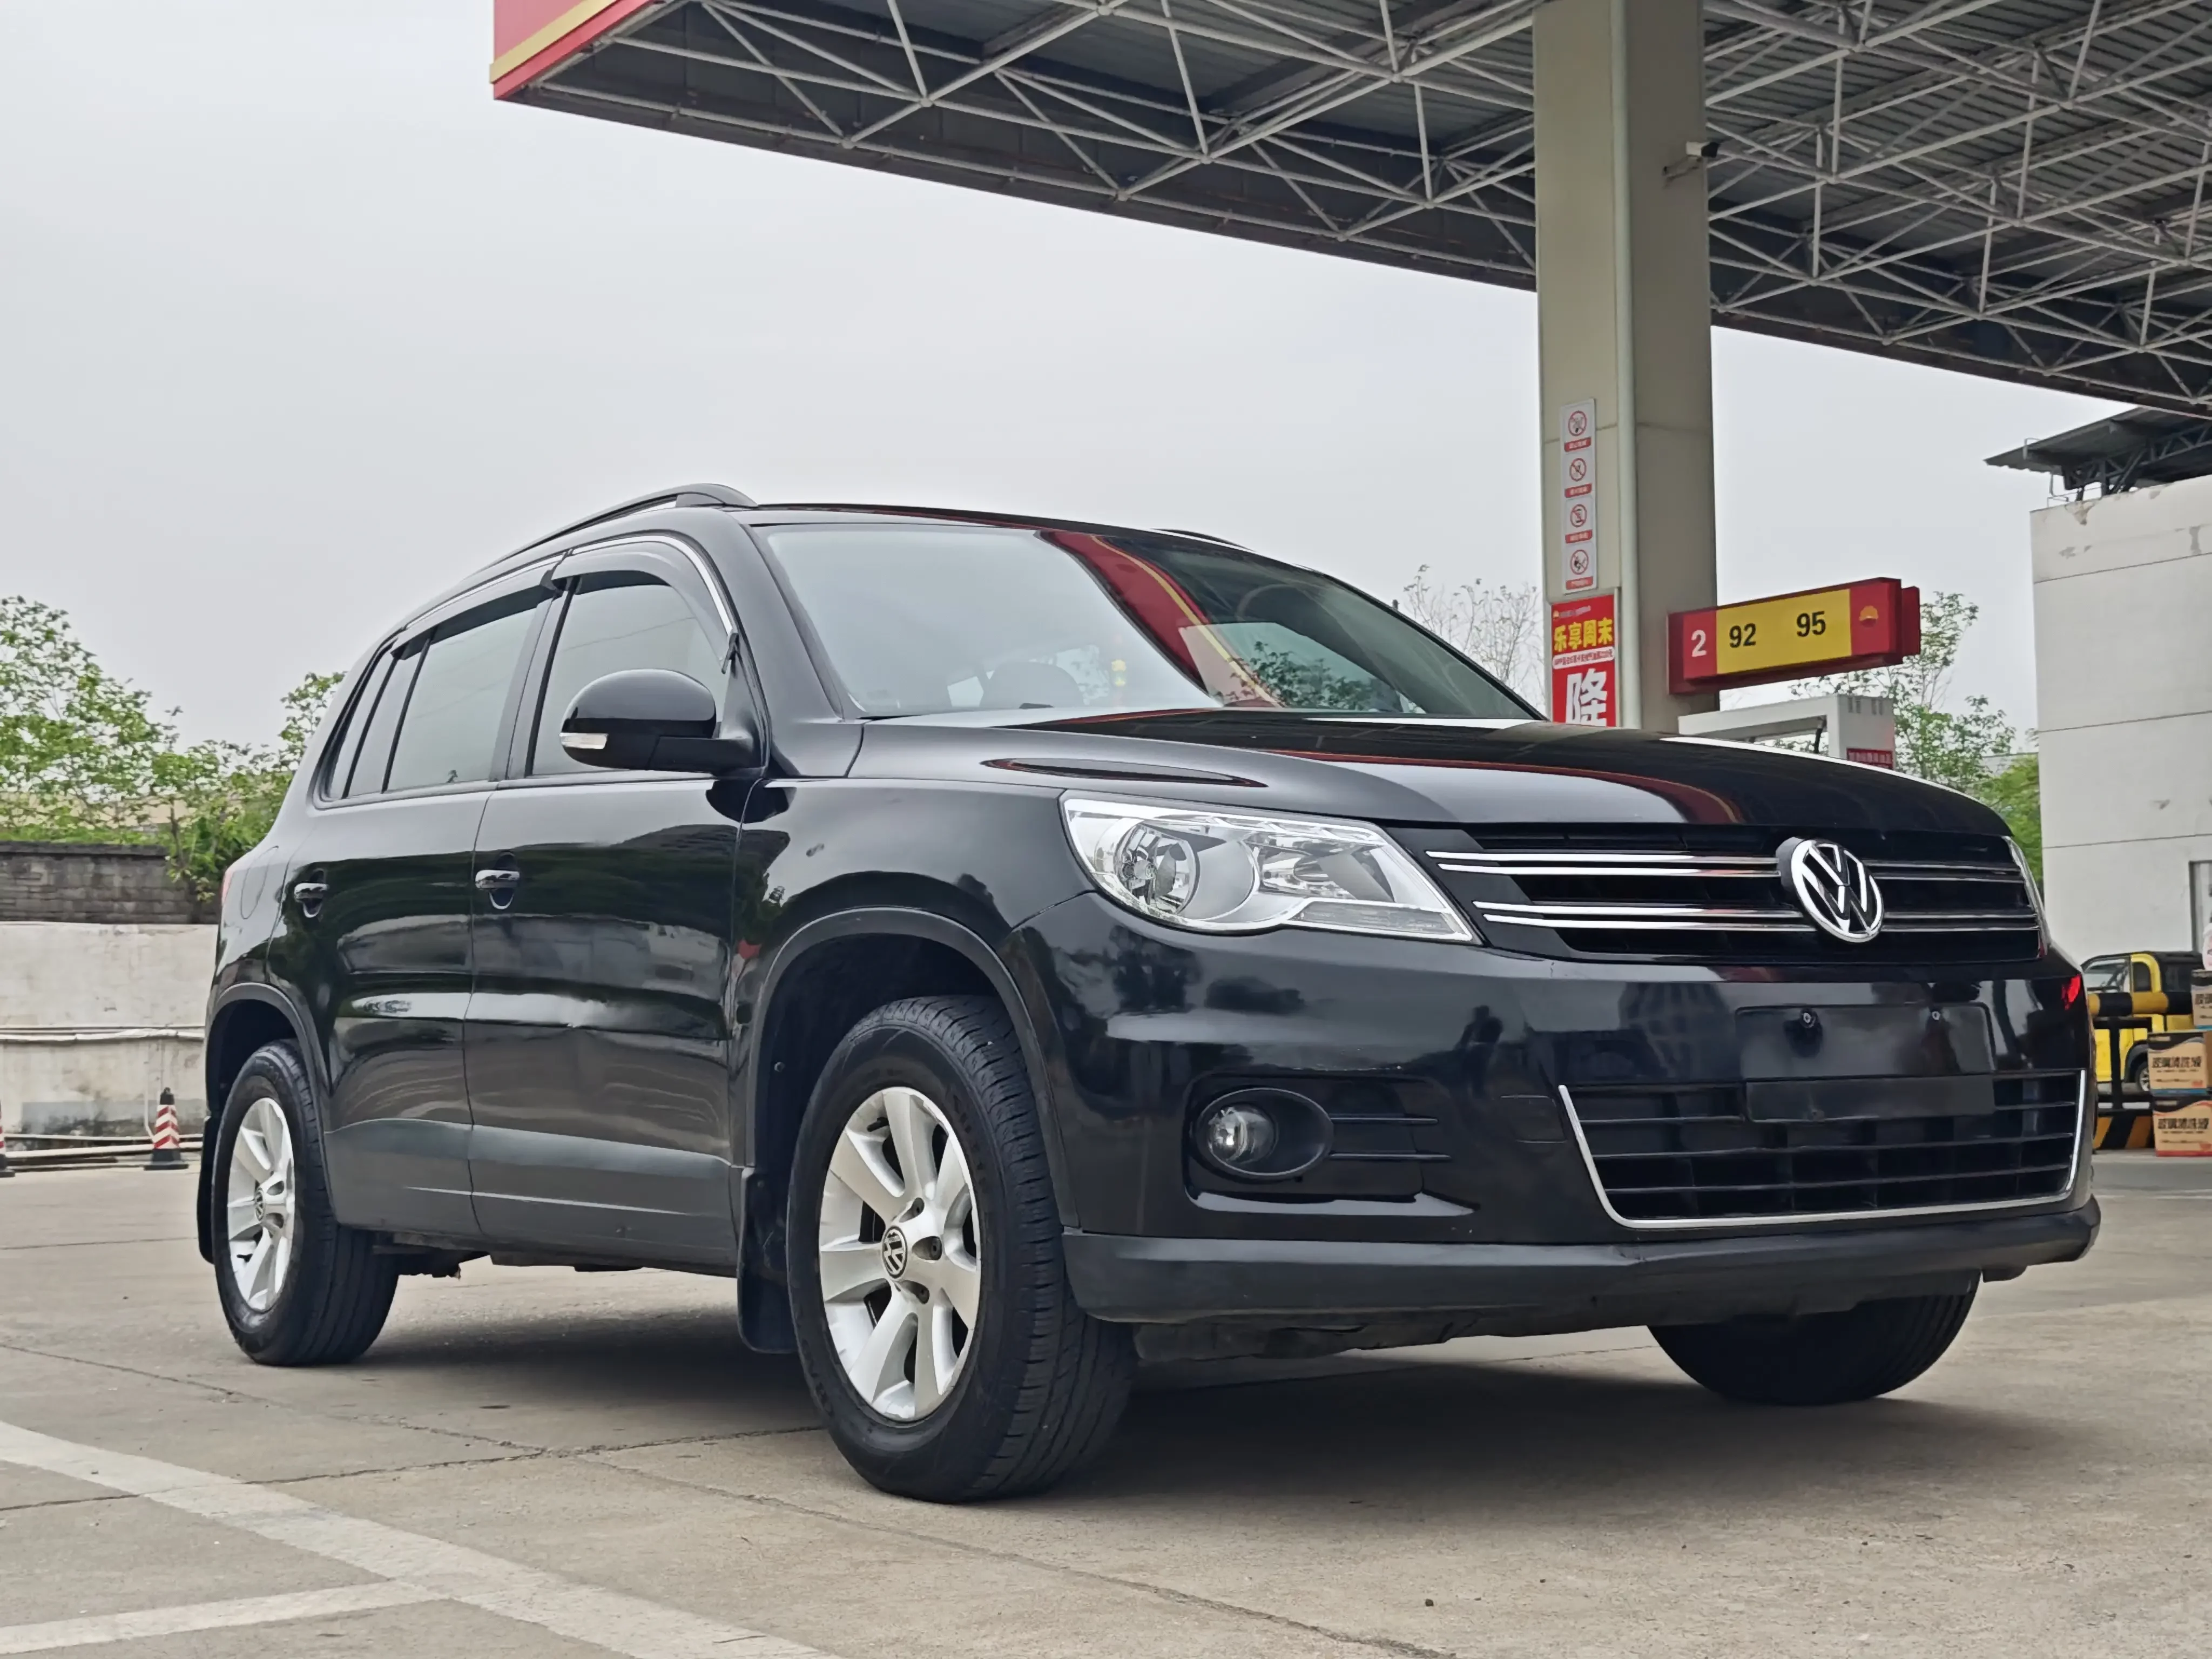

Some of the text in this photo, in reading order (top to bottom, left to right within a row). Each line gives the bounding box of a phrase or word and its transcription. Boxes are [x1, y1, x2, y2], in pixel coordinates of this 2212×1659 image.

[1554, 617, 1613, 652] 乐享周末
[1691, 611, 1826, 657] 2 92 95
[1566, 667, 1608, 727] 降
